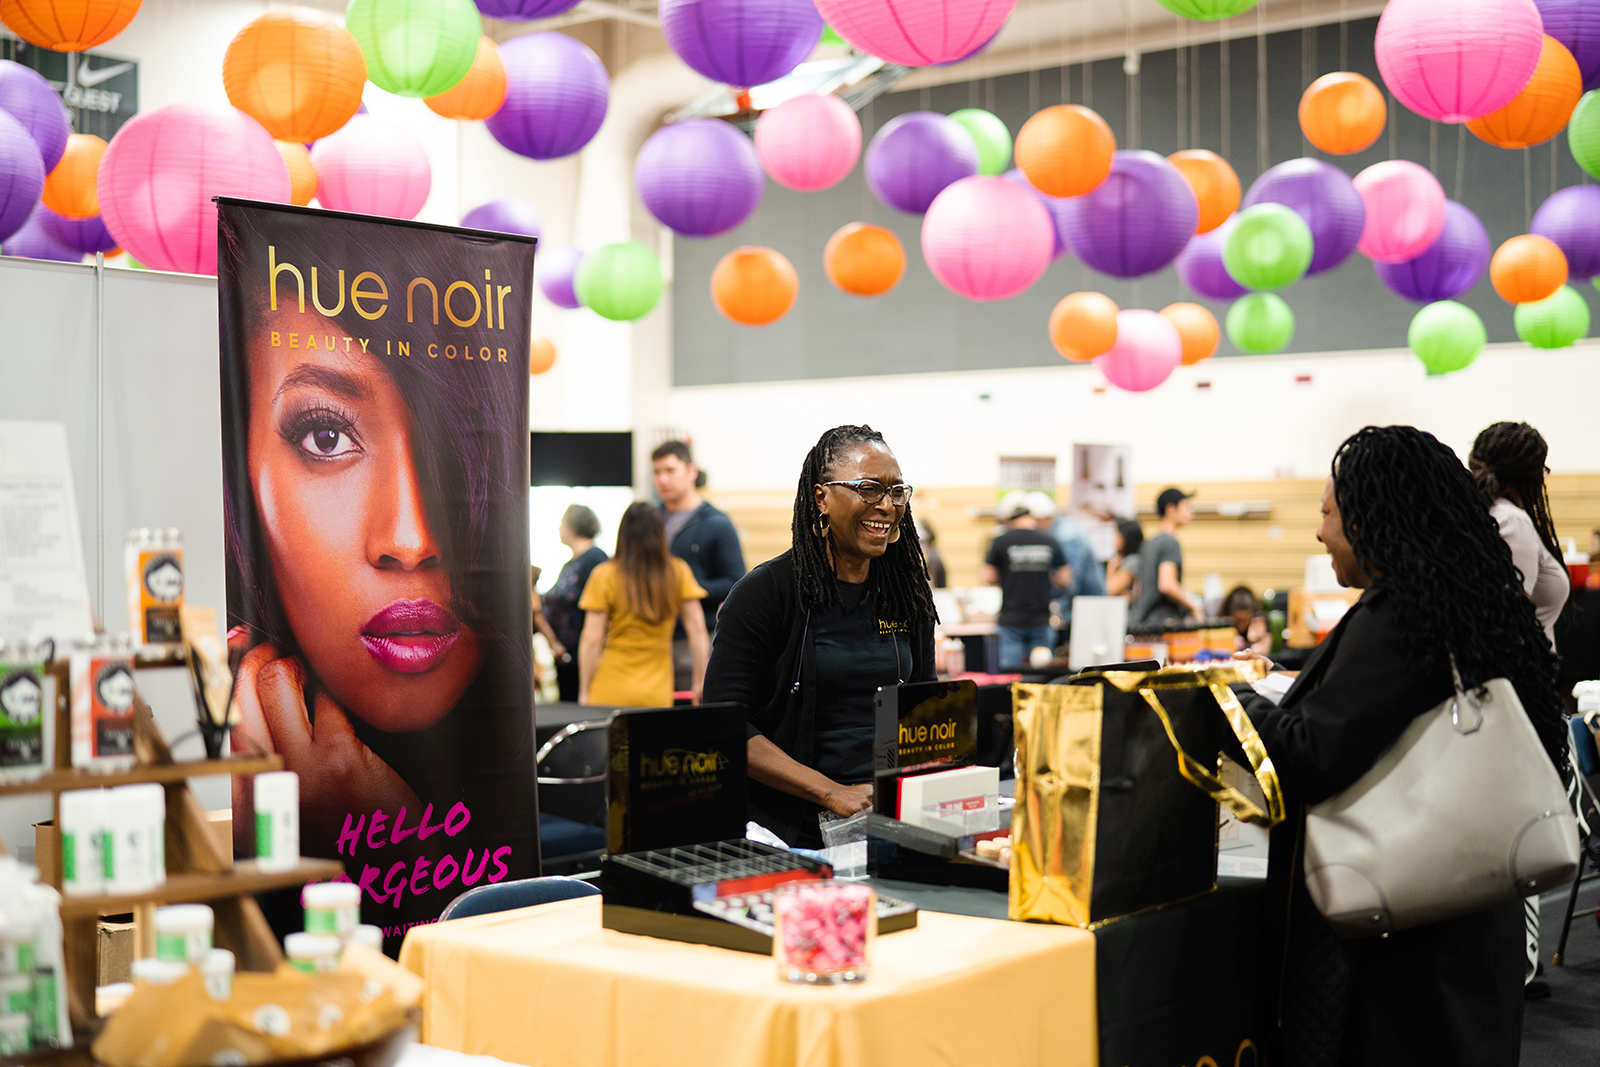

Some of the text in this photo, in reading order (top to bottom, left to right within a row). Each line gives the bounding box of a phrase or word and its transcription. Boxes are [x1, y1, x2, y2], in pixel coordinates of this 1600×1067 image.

[268, 245, 512, 330] hue noir
[271, 331, 508, 363] BEAUTY IN COLOR
[878, 618, 898, 629] hue
[898, 718, 957, 744] hue noir
[334, 801, 471, 857] HELLO
[300, 845, 513, 909] RGEOUS
